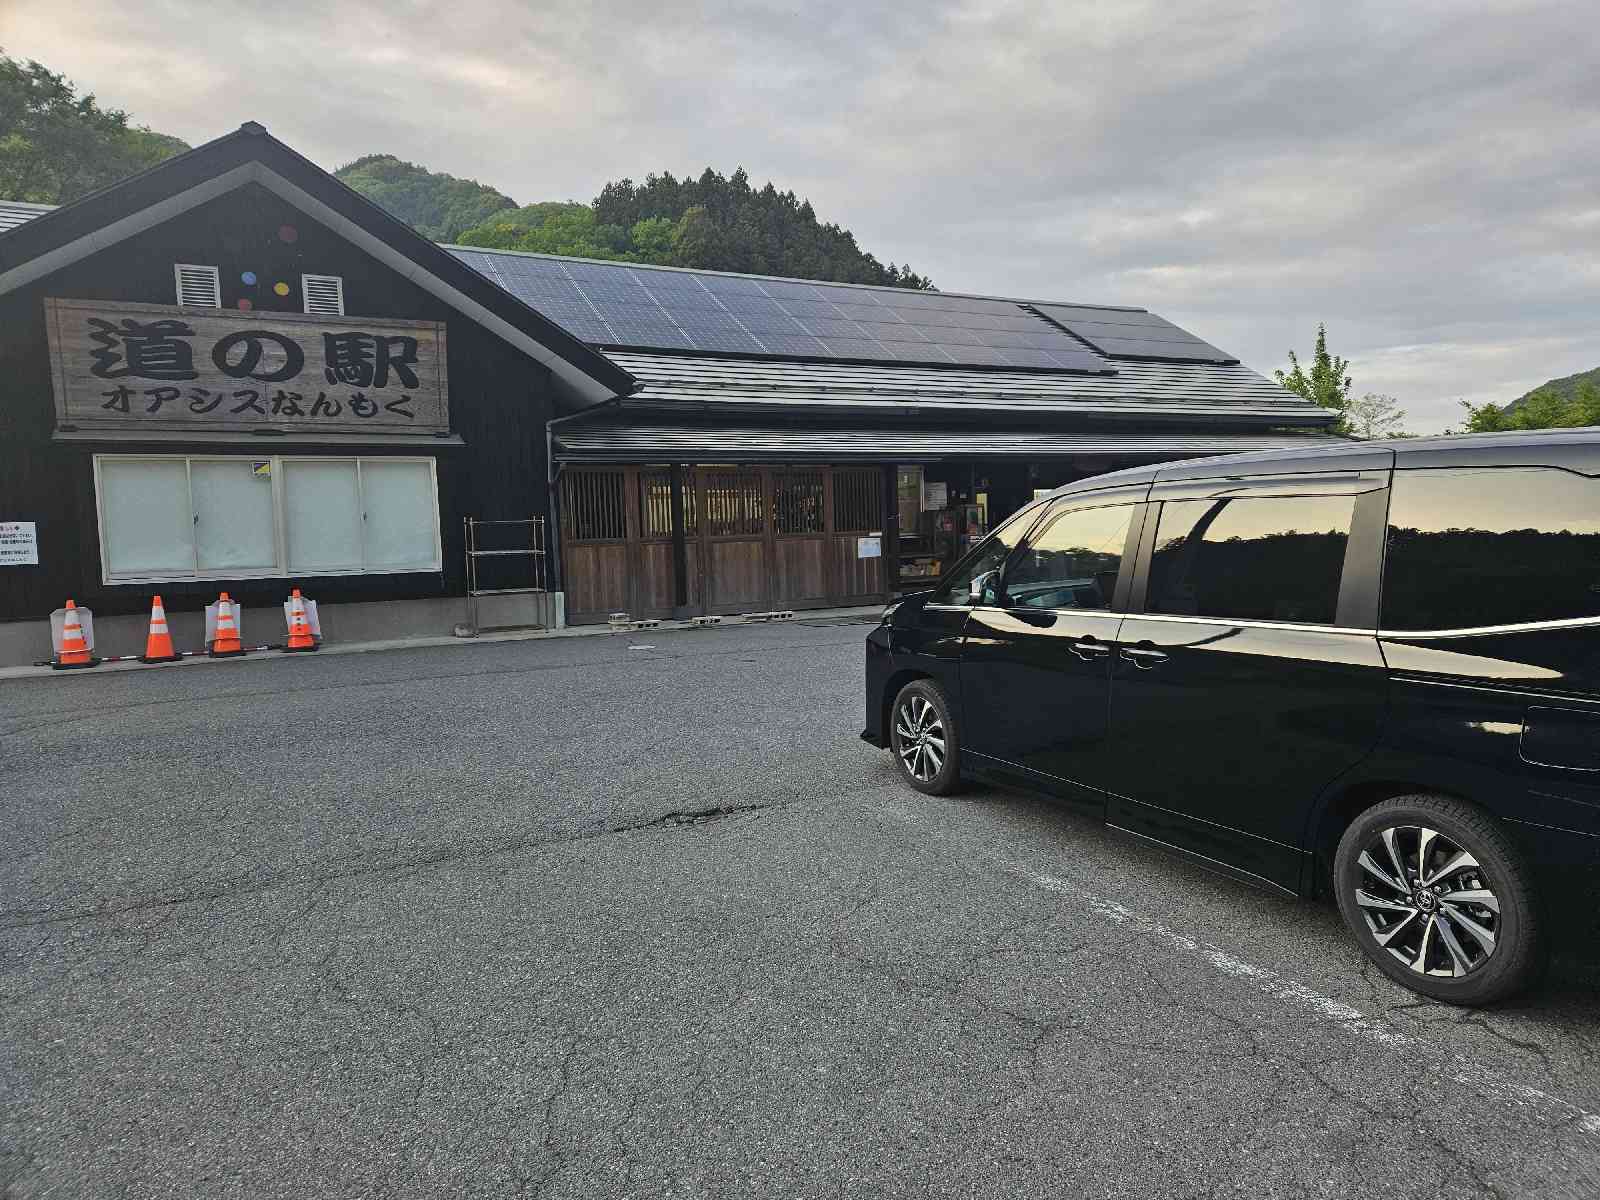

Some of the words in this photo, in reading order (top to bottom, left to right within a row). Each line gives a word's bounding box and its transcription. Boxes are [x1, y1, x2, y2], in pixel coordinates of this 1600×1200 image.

[87, 317, 420, 389] 道の駅
[101, 385, 415, 418] オアシスなんもく
